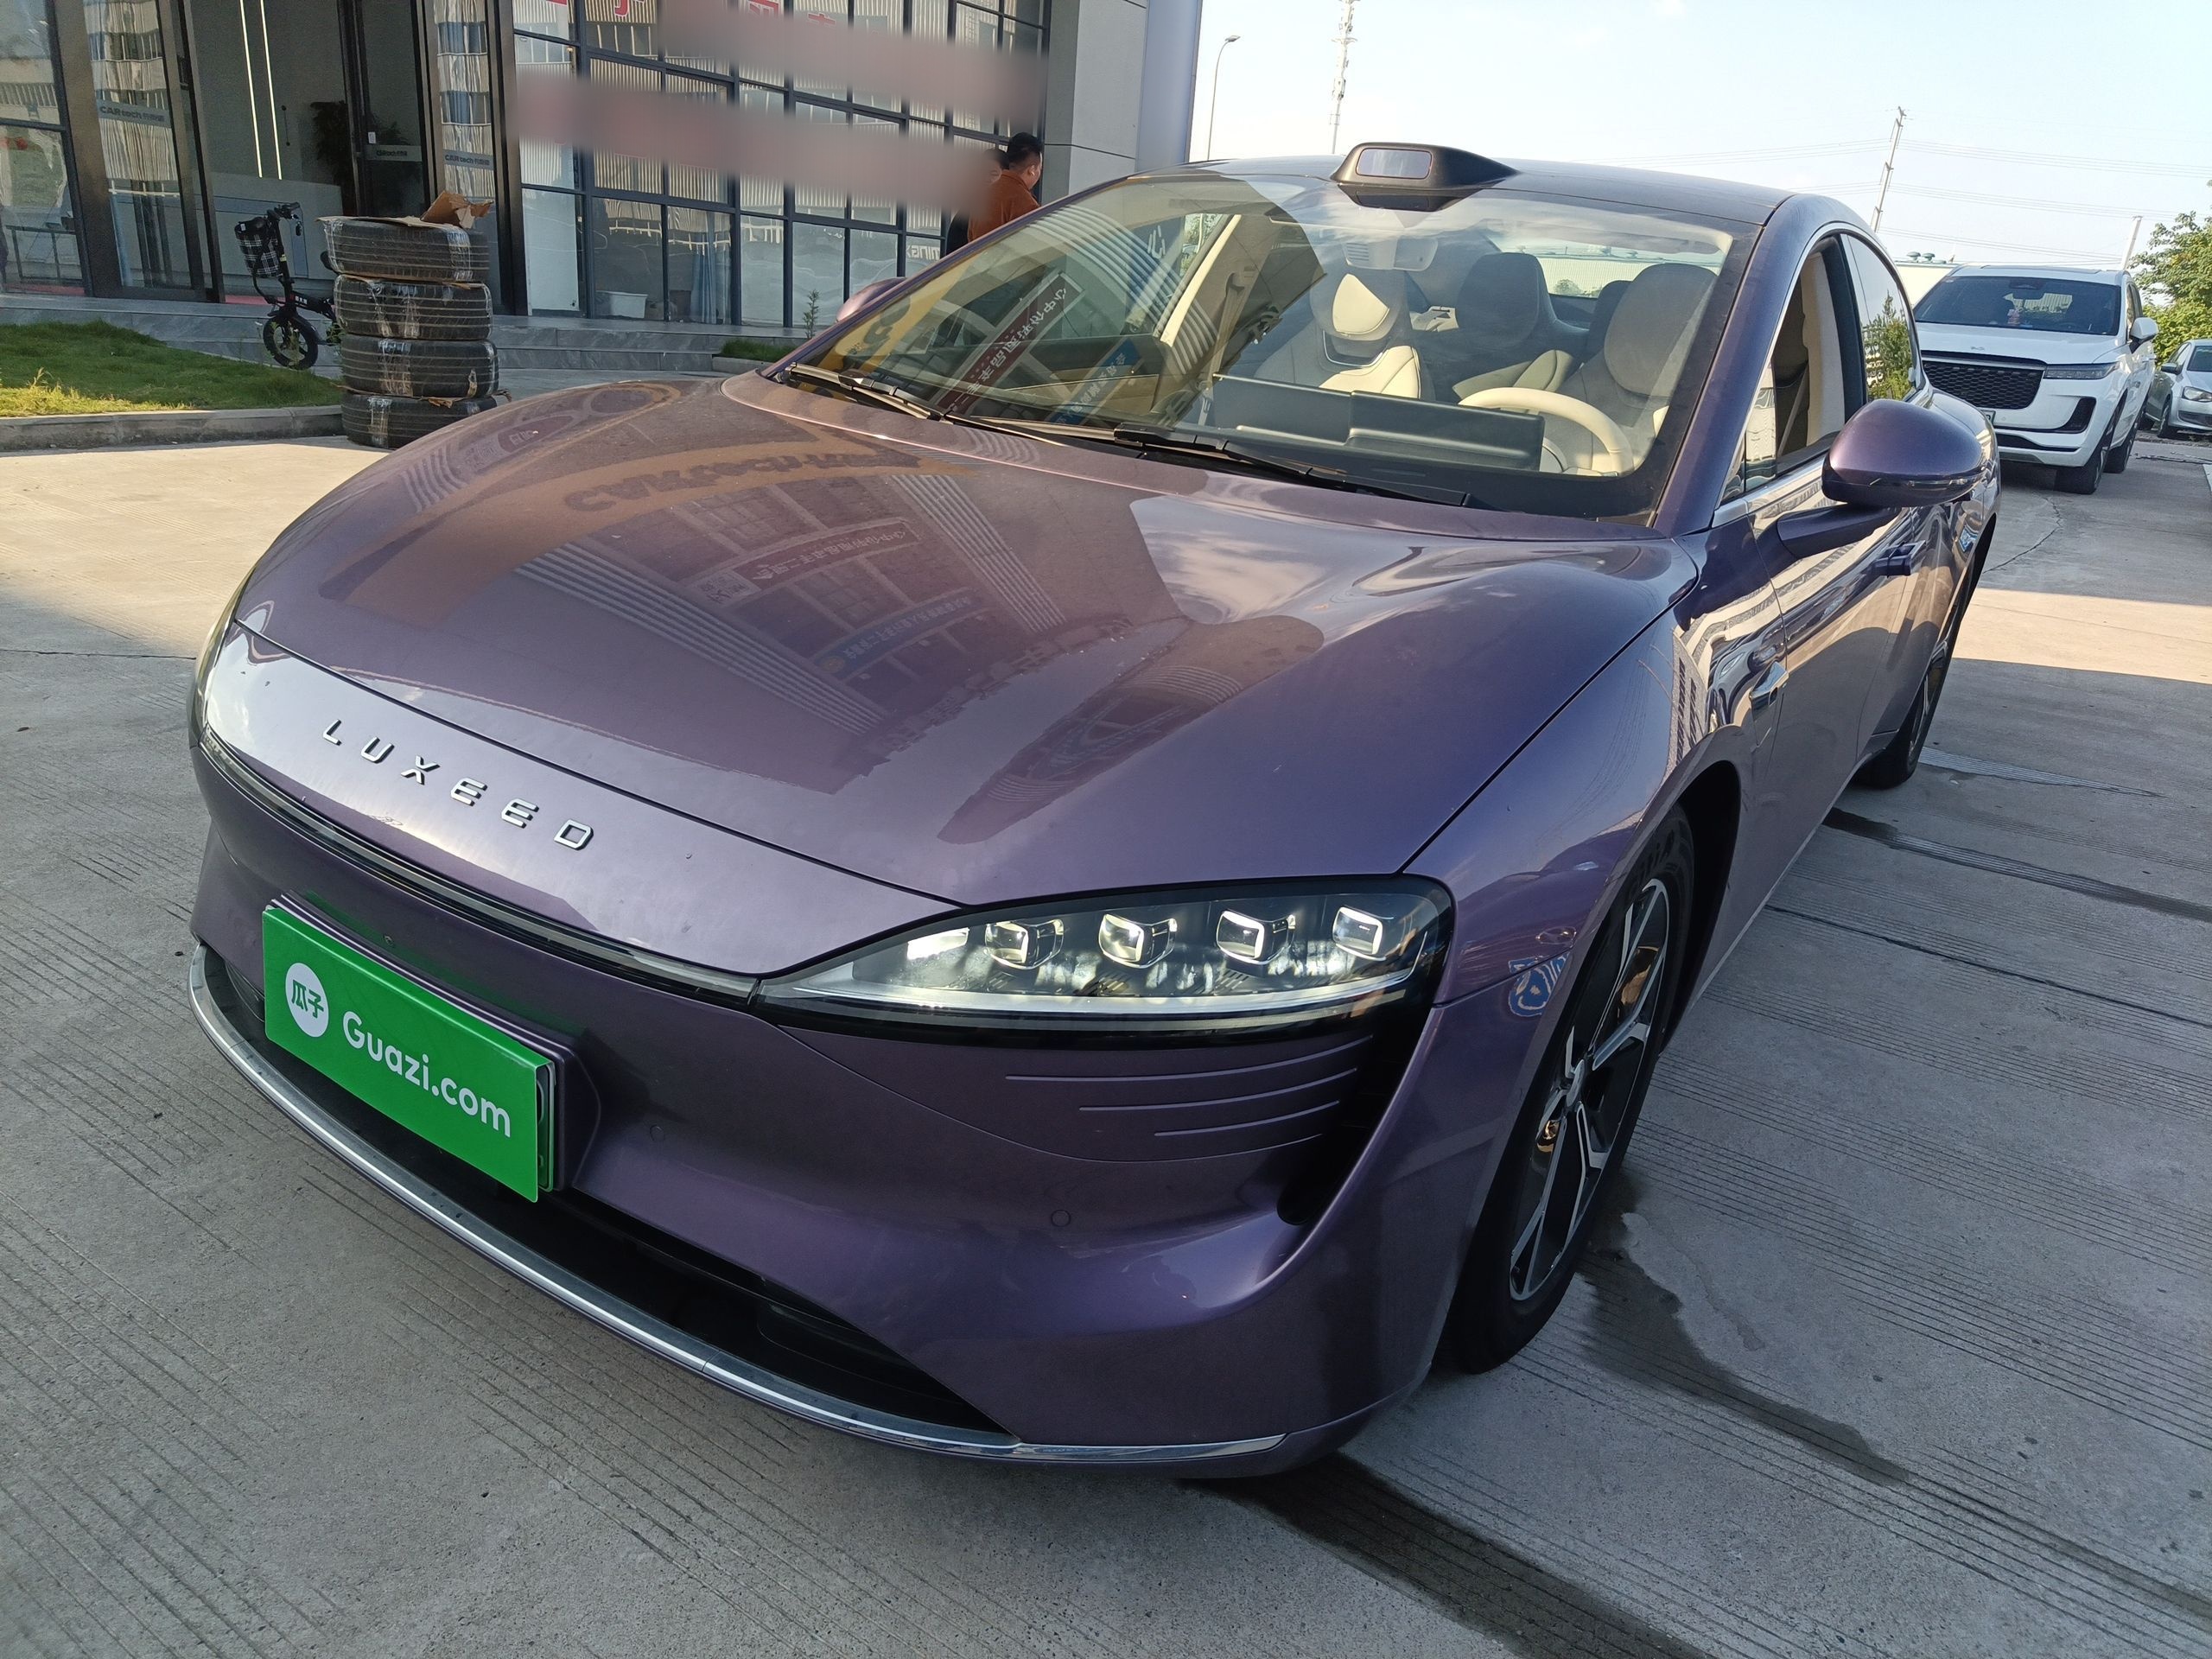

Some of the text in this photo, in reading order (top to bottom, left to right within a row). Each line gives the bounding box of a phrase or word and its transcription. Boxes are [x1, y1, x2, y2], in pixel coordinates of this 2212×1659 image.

[322, 718, 594, 850] LUXEED
[290, 979, 325, 1019] 瓜子
[342, 1010, 512, 1139] Guazi.com
